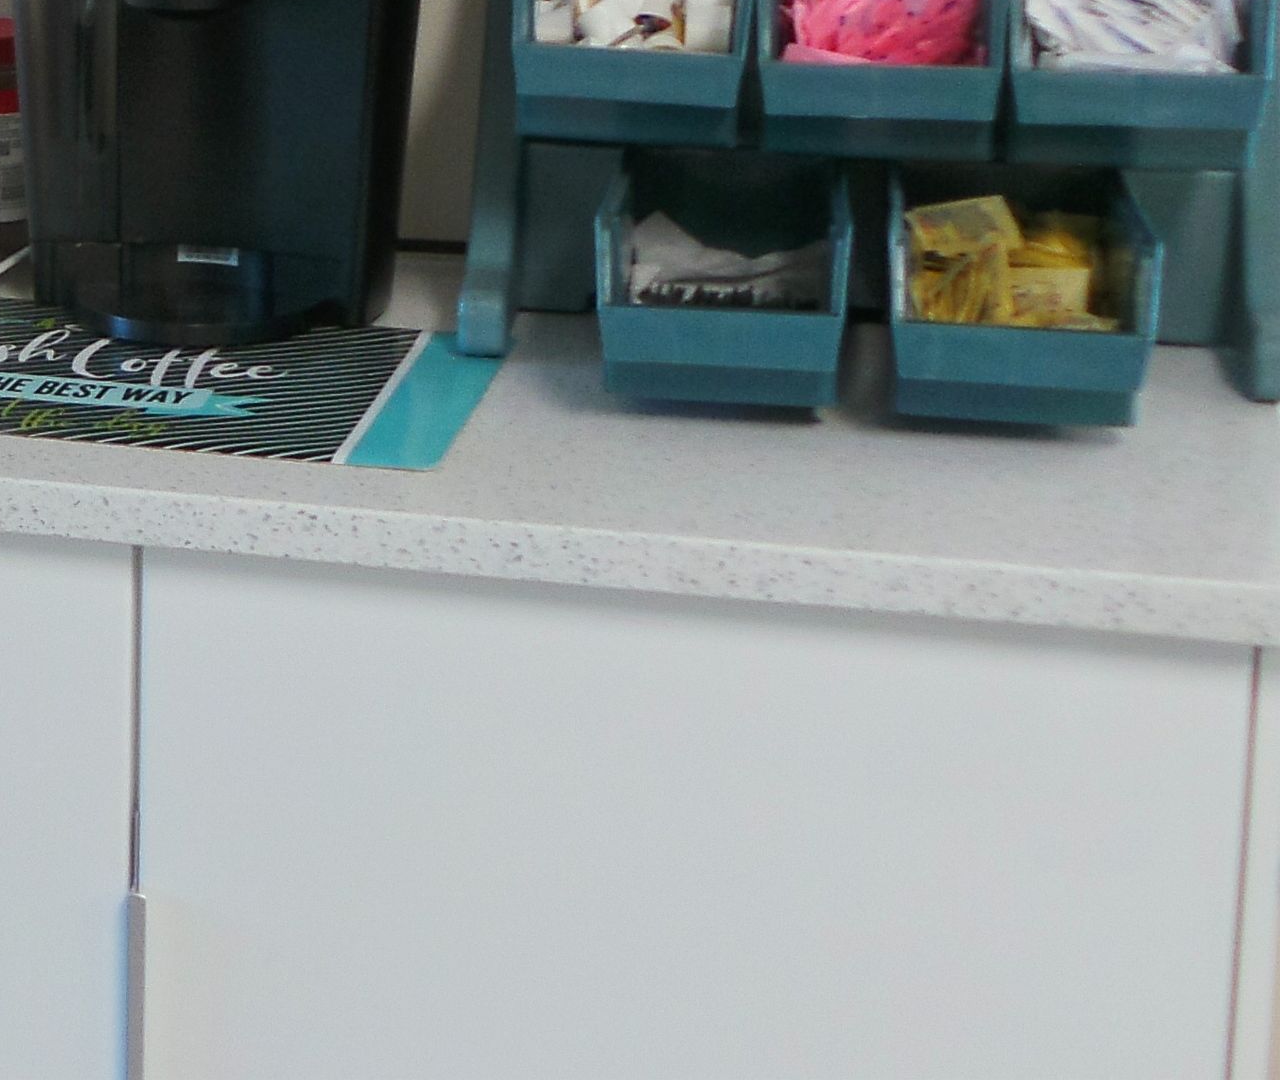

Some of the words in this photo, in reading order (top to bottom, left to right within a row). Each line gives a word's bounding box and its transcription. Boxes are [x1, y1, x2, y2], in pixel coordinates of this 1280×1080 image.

[72, 338, 288, 388] Coffee
[34, 380, 117, 400] BEST
[121, 387, 195, 404] WAY
